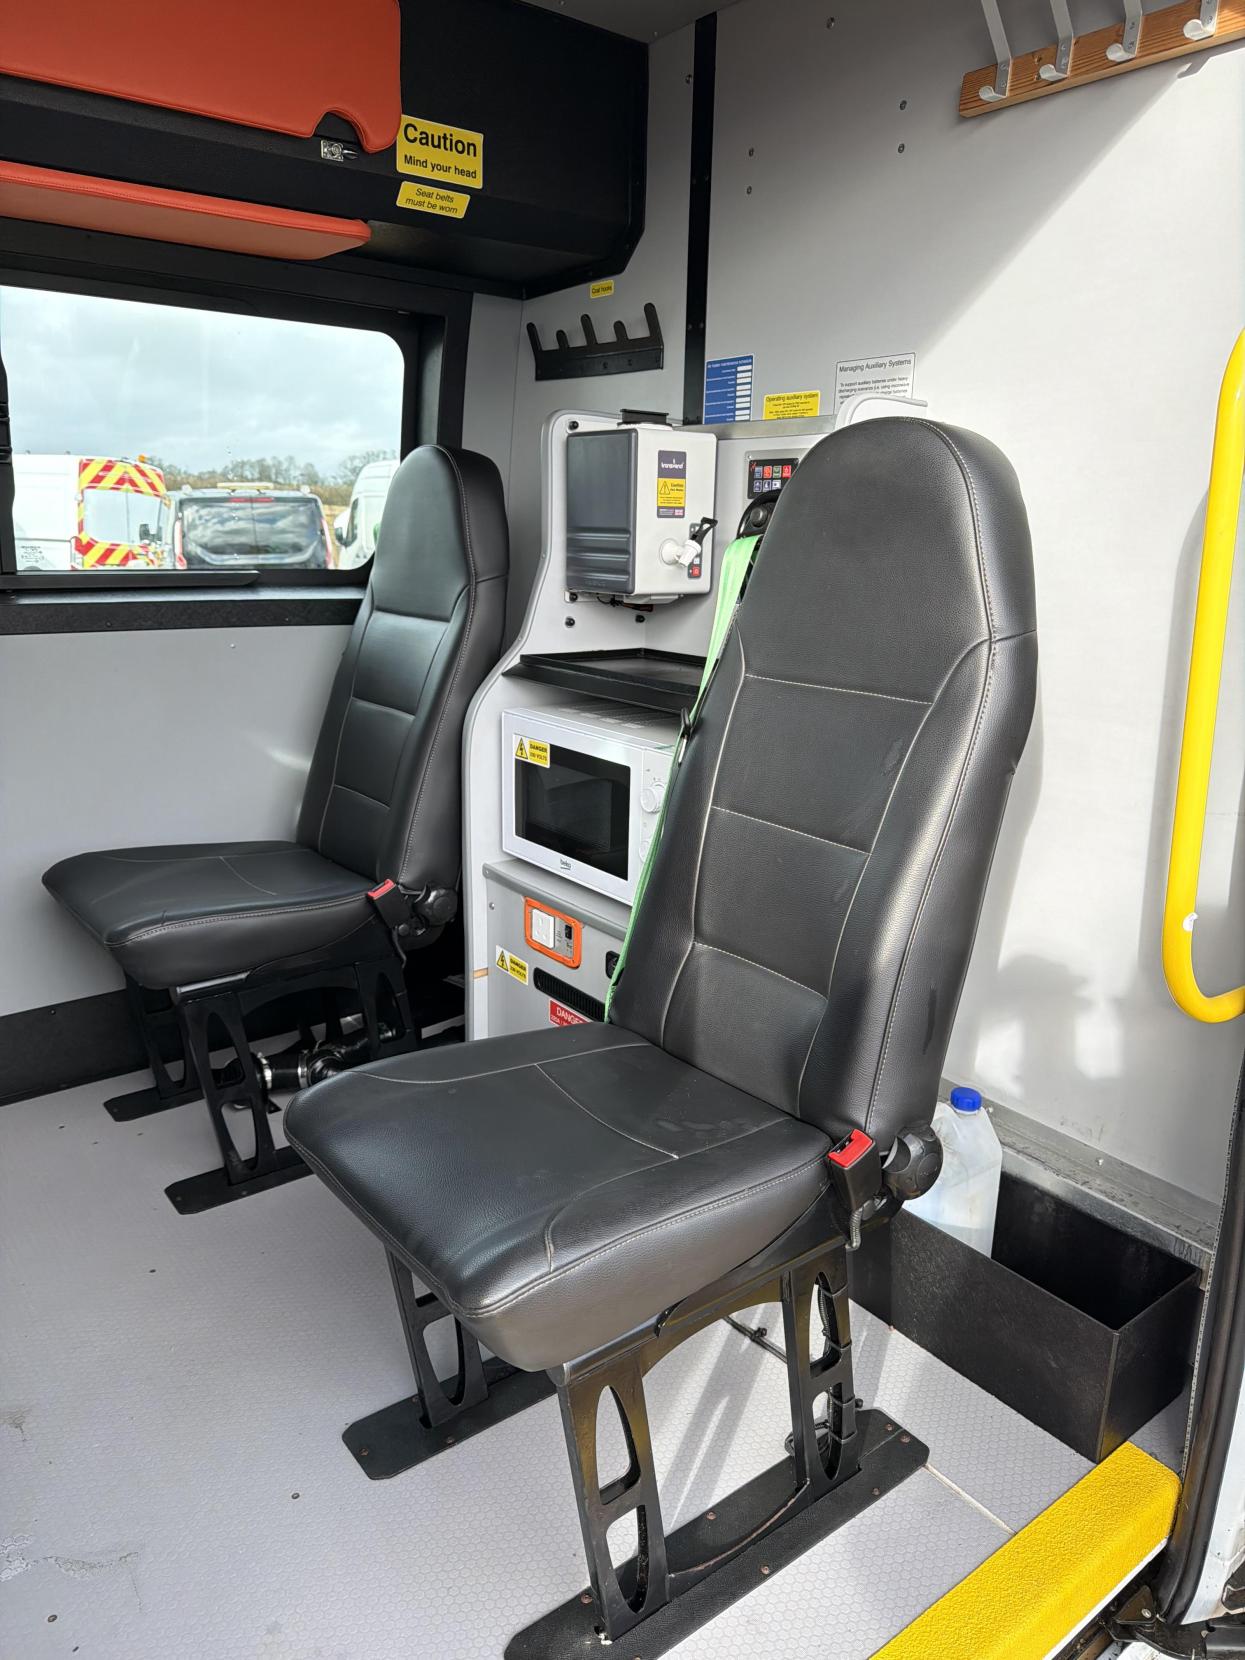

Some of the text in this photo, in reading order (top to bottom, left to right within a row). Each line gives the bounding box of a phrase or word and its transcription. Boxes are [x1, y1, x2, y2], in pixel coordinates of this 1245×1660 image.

[403, 123, 477, 157] Caution
[404, 154, 477, 178] Mind your head
[415, 188, 454, 203] Seat belts
[405, 197, 458, 214] must be worn
[839, 359, 912, 373] Managing Auxiliary Systems
[529, 743, 548, 753] DANGER
[560, 858, 571, 868] beko
[510, 958, 526, 972] DANGER
[556, 1007, 583, 1024] DANGE
